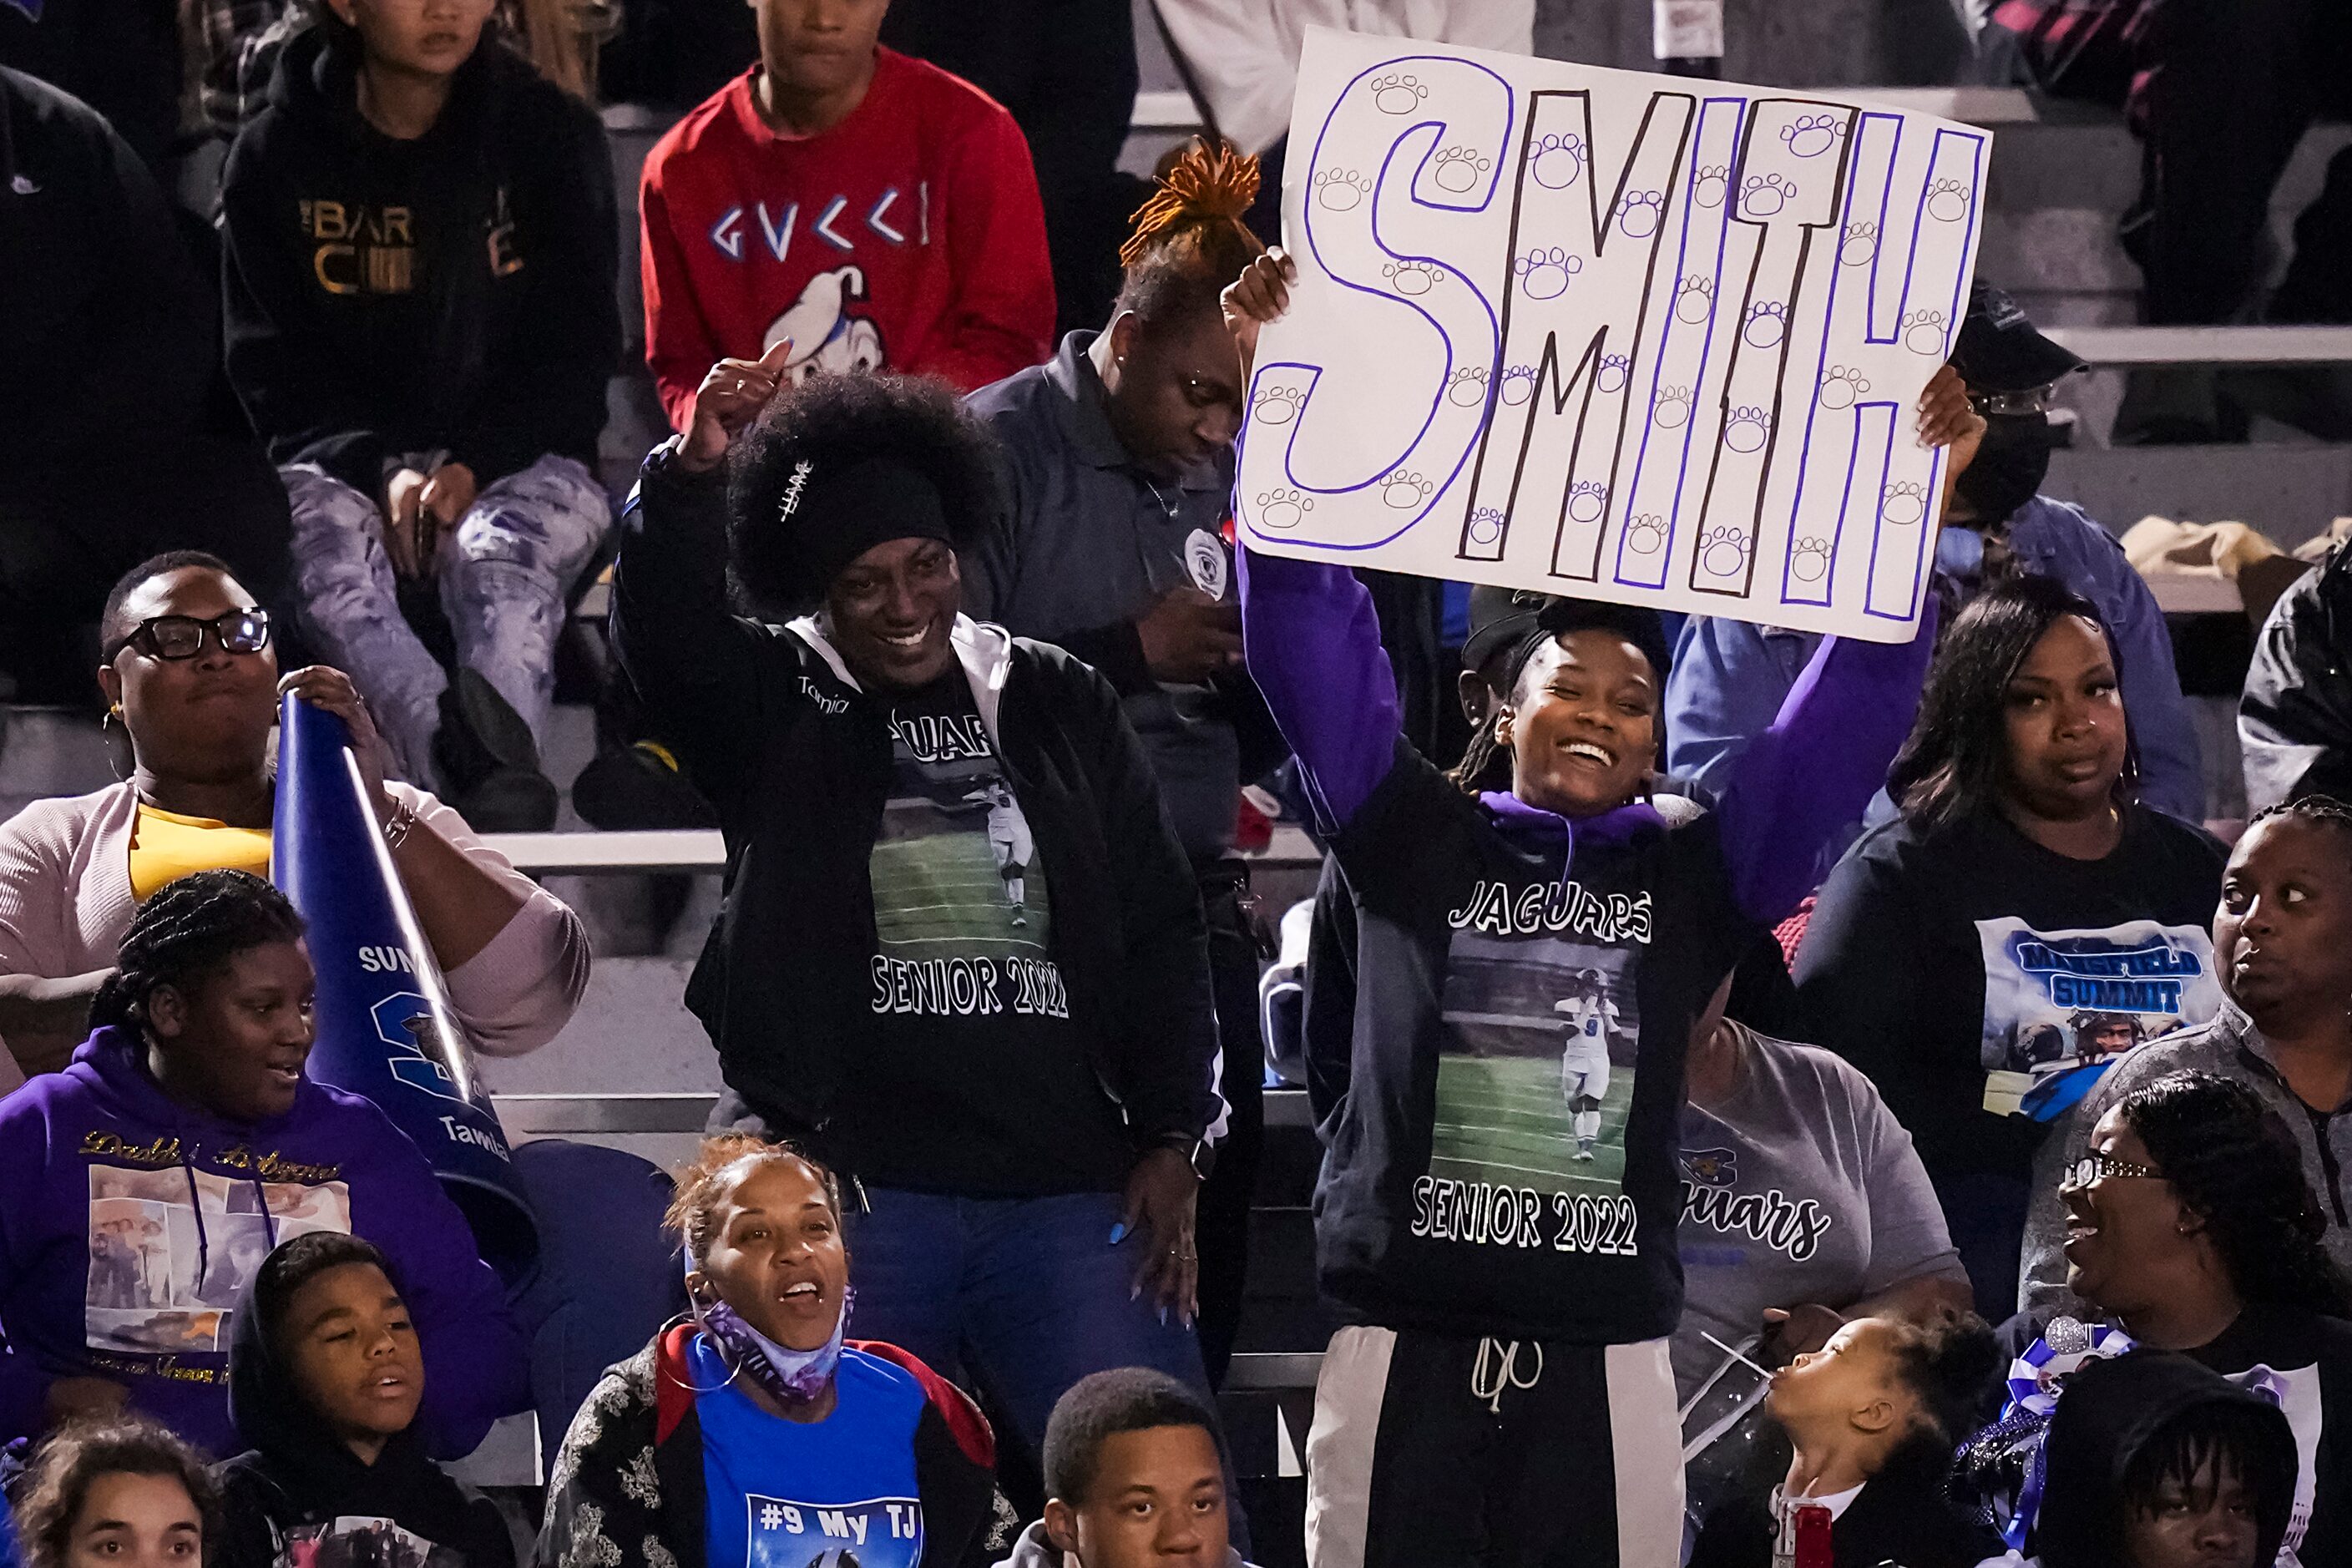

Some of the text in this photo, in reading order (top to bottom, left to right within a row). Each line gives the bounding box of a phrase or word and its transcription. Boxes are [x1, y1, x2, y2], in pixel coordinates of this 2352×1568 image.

[1237, 55, 1985, 622] SMITH
[797, 676, 850, 714] Tamia
[1448, 880, 1652, 943] JAGUARS
[870, 954, 1070, 1019] SENIOR 2022
[2051, 974, 2183, 1014] SUMMIT
[1411, 1175, 1638, 1256] SENIOR 2022
[760, 1504, 916, 1545] #9 My TJ
